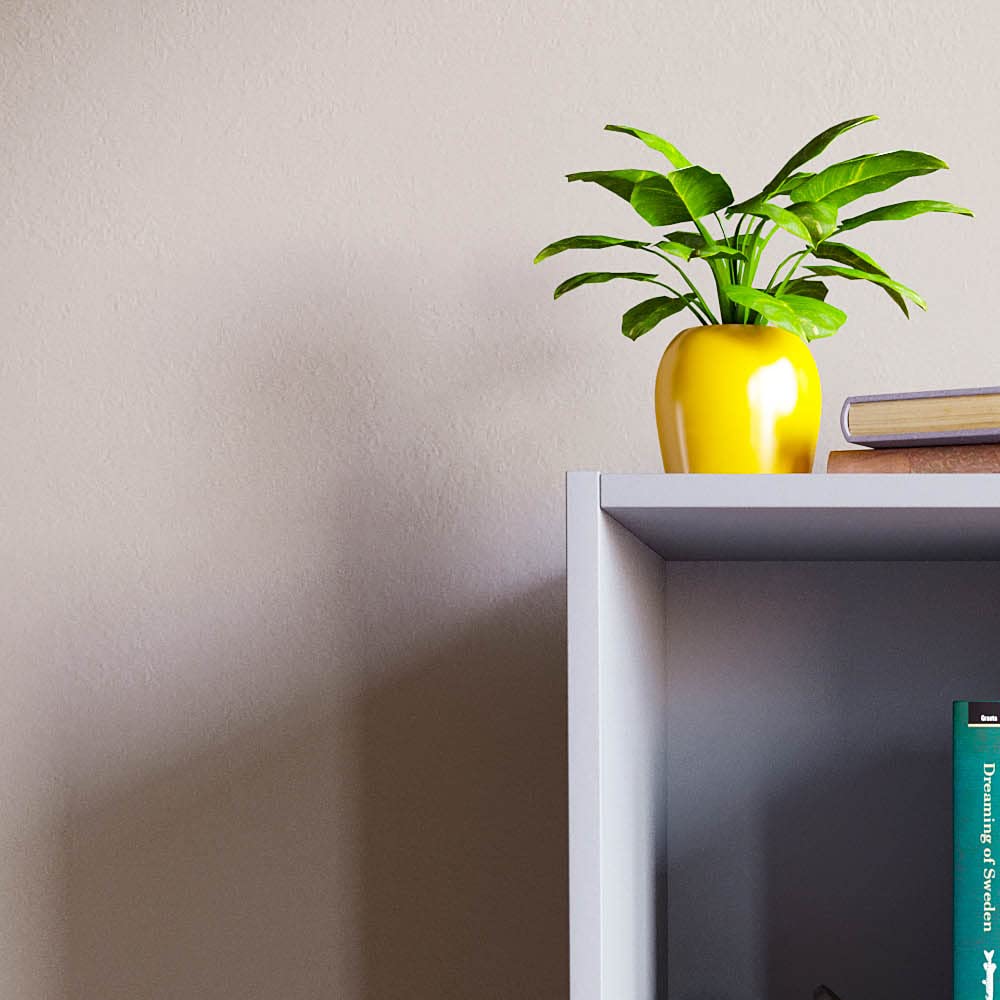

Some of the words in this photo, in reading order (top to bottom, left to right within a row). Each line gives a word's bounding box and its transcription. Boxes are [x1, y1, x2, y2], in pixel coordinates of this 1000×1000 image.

[979, 763, 996, 844] Dreaming
[983, 848, 996, 866] of
[983, 868, 996, 932] Sweden
